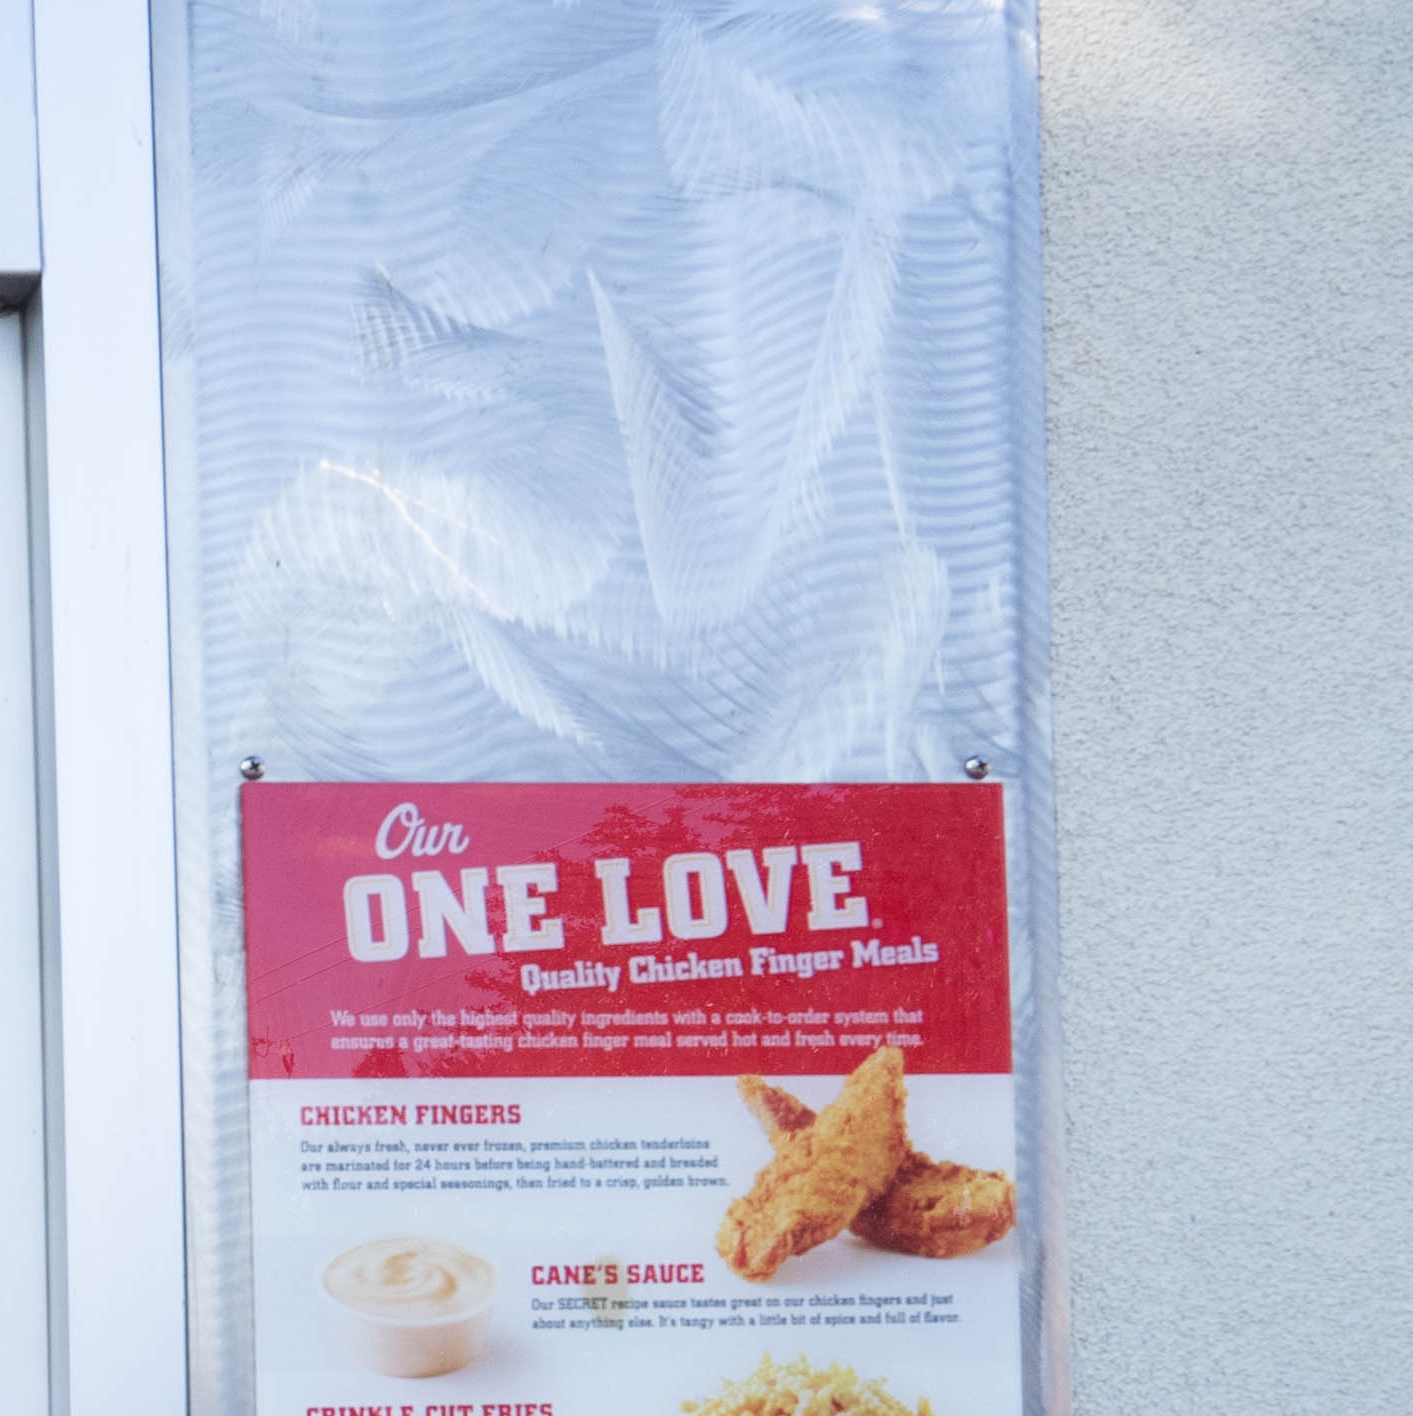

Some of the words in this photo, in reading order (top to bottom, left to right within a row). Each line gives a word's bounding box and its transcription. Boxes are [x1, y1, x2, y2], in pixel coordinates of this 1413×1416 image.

[374, 802, 470, 860] Our
[342, 863, 565, 964] ONE
[520, 961, 620, 995] Quality
[629, 952, 743, 984] Chicken
[750, 946, 844, 977] Finger
[850, 936, 939, 968] Meals
[331, 1010, 355, 1026] We
[360, 1013, 388, 1026] use
[393, 1010, 426, 1029] only
[431, 1010, 456, 1025] the
[460, 1009, 518, 1029] highest
[523, 1009, 576, 1028] quality
[581, 1009, 668, 1028] ingredients
[674, 1008, 706, 1024] with
[835, 1011, 888, 1027] system
[893, 1007, 923, 1023] that
[331, 1036, 394, 1049] ensures
[518, 1033, 578, 1048] chicken
[583, 1033, 629, 1050] finger
[634, 1031, 671, 1047] meal
[677, 1031, 727, 1046] served
[733, 1031, 758, 1046] hot
[762, 1031, 790, 1046] and
[796, 1031, 834, 1046] fresh
[839, 1033, 881, 1048] every
[300, 1105, 407, 1125] CHICKEN
[415, 1104, 521, 1124] FINGERS
[301, 1140, 323, 1153] Our
[531, 1265, 618, 1285] CANE'S
[626, 1263, 705, 1283] SAUCE
